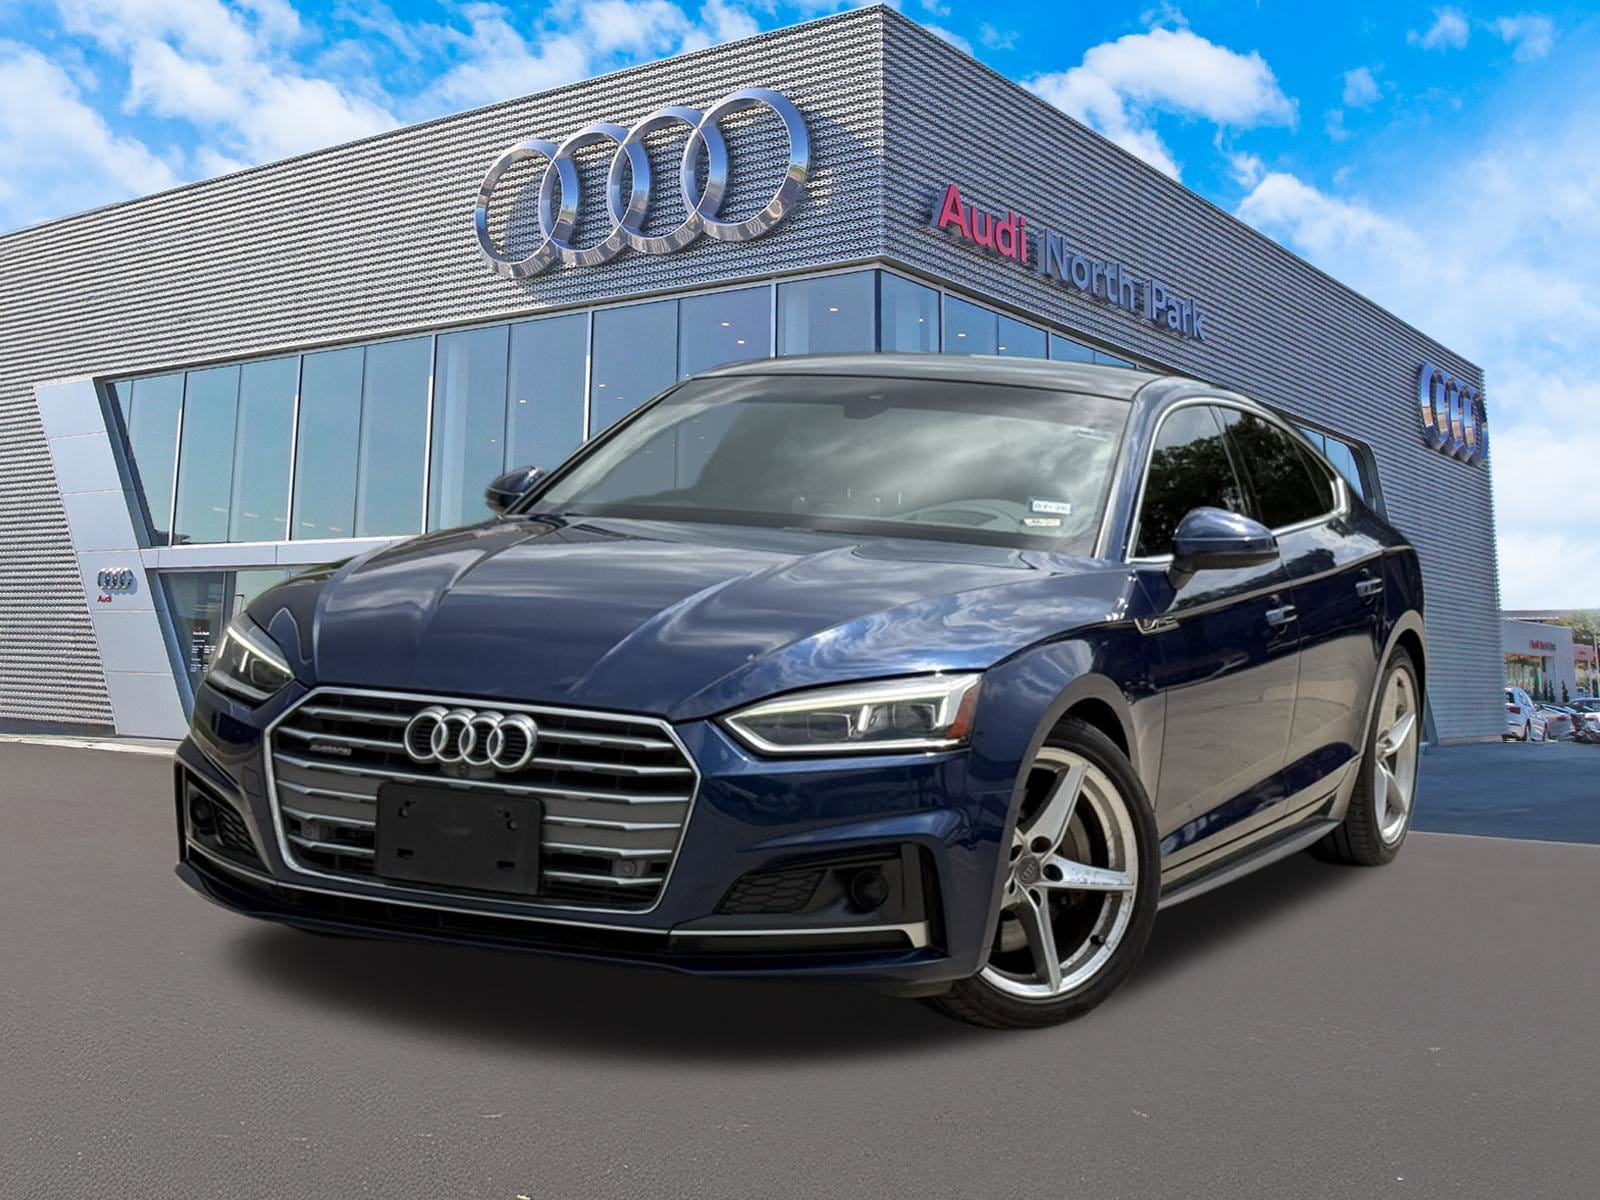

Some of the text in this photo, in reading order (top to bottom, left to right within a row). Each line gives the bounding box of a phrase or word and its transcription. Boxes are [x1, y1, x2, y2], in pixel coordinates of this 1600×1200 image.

[934, 183, 1206, 341] Audi North Park
[97, 595, 112, 603] Audi
